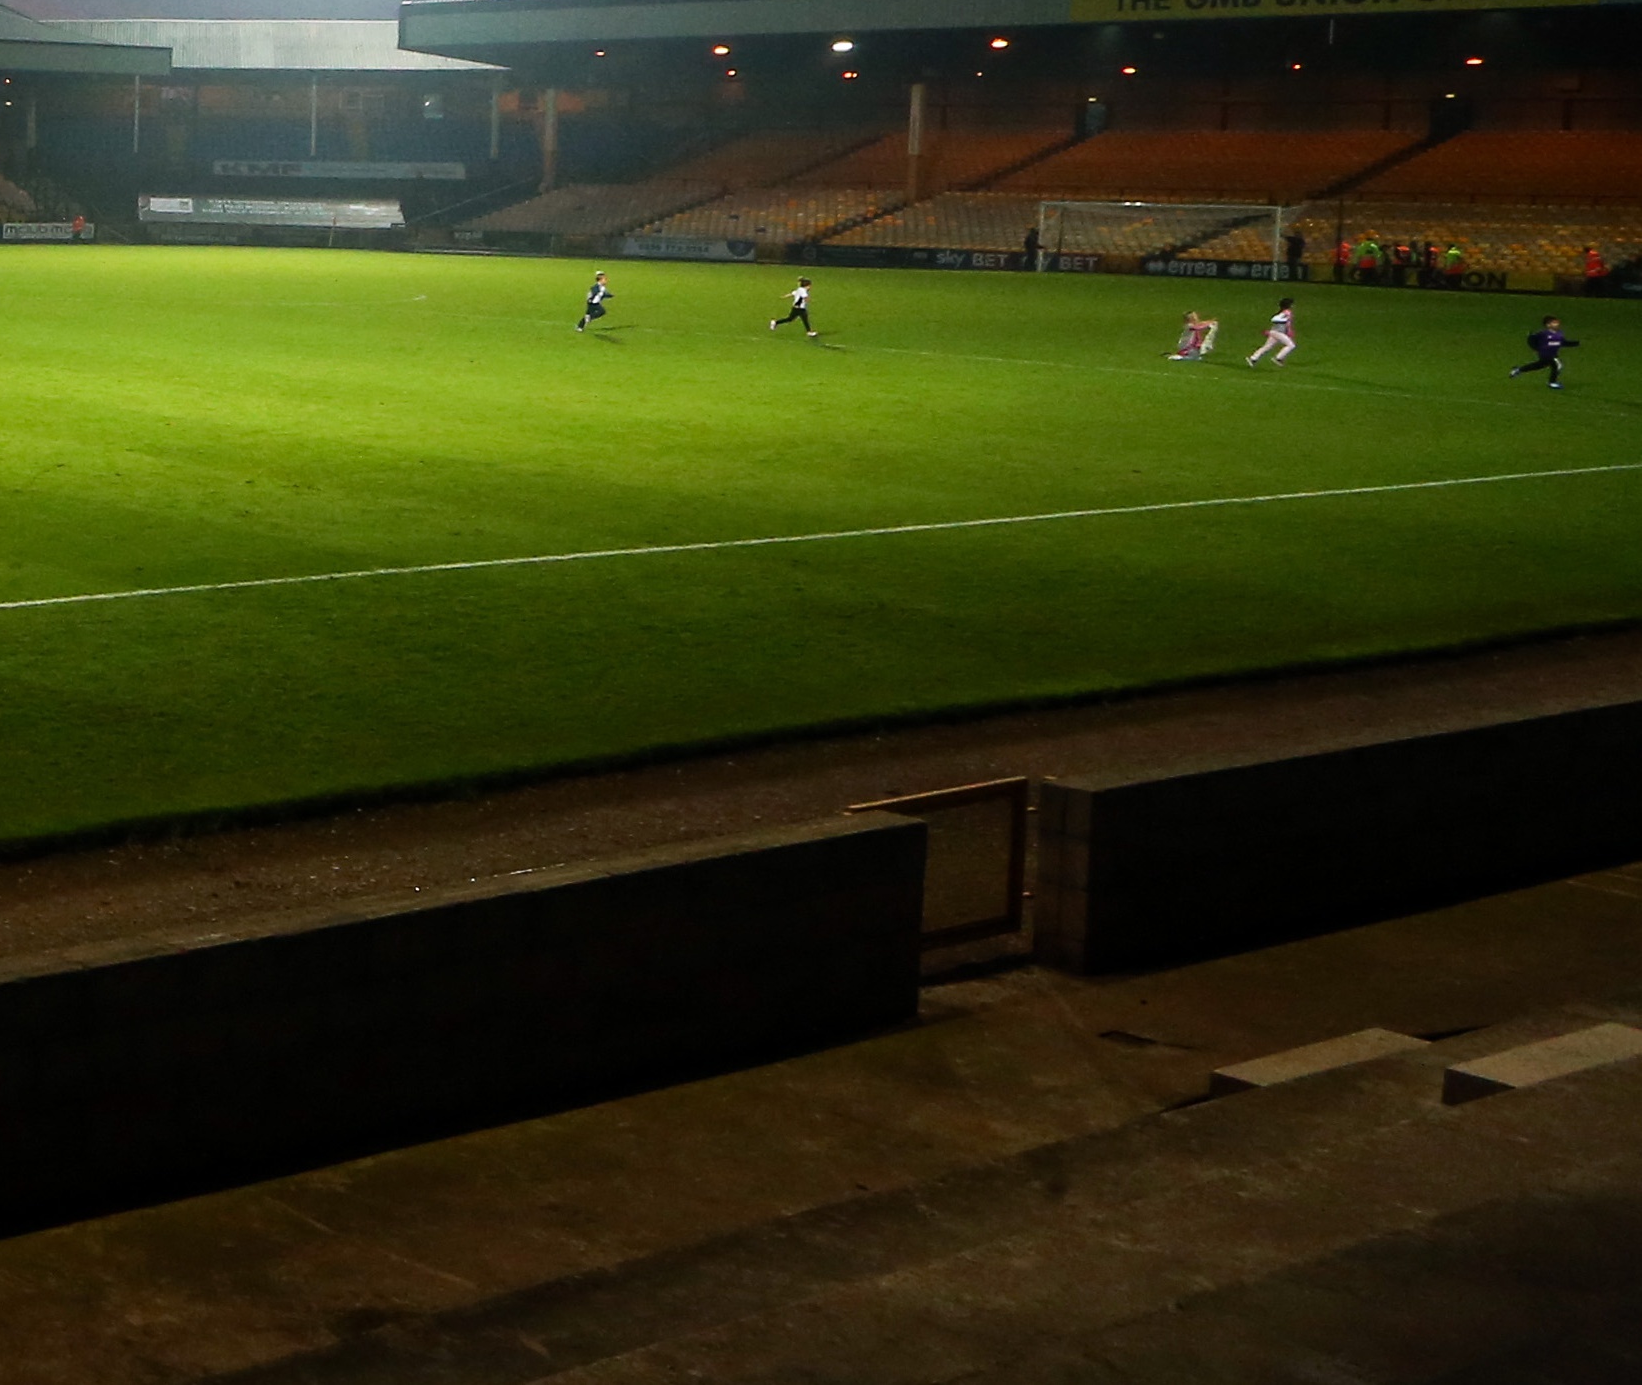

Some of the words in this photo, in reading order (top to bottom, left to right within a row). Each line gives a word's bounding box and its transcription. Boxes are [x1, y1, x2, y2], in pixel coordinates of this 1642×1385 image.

[936, 251, 966, 269] sky
[972, 253, 1009, 267] BET
[1059, 256, 1099, 272] BET
[1168, 261, 1217, 276] errea
